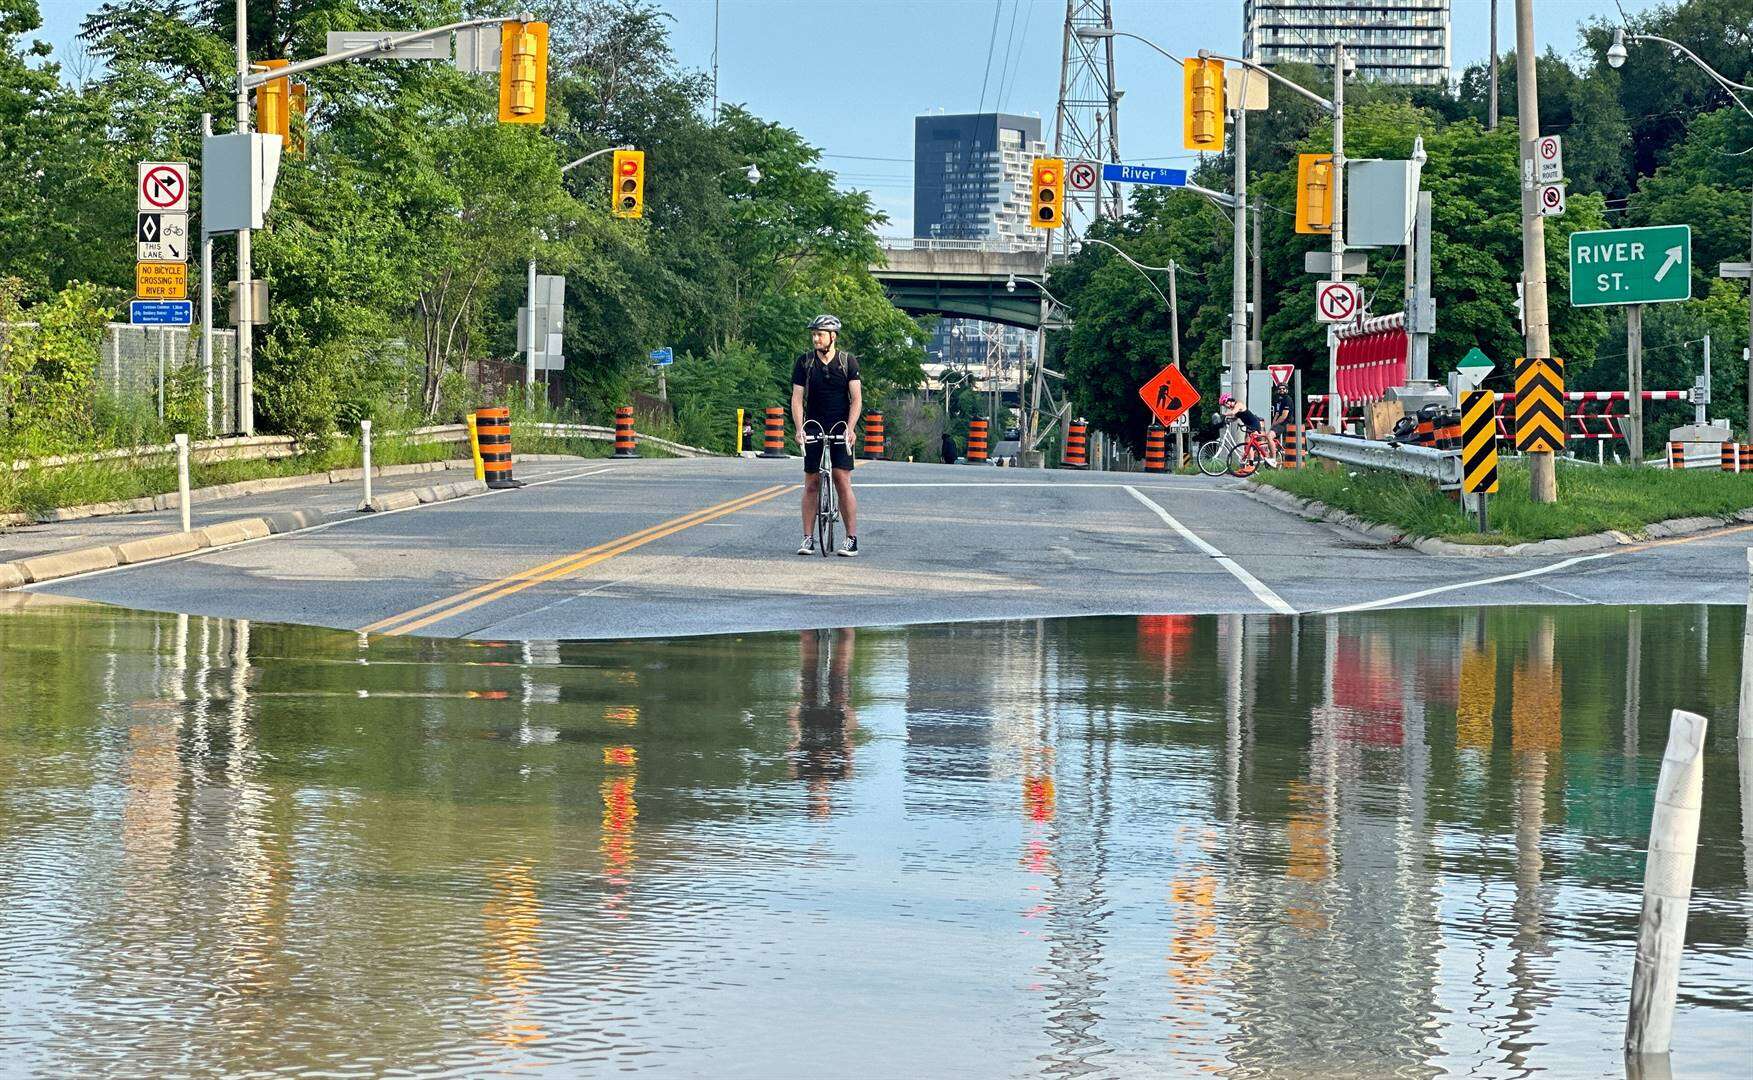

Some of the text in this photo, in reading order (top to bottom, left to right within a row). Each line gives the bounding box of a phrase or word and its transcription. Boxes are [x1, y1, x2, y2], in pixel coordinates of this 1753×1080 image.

[1122, 166, 1156, 180] River
[1542, 171, 1558, 179] ROUTE
[1577, 242, 1645, 264] RIVER
[142, 266, 181, 274] NO BICYCLE
[140, 276, 183, 285] CROSSING TO
[1597, 272, 1630, 292] ST.
[145, 287, 176, 295] RIVER ST
